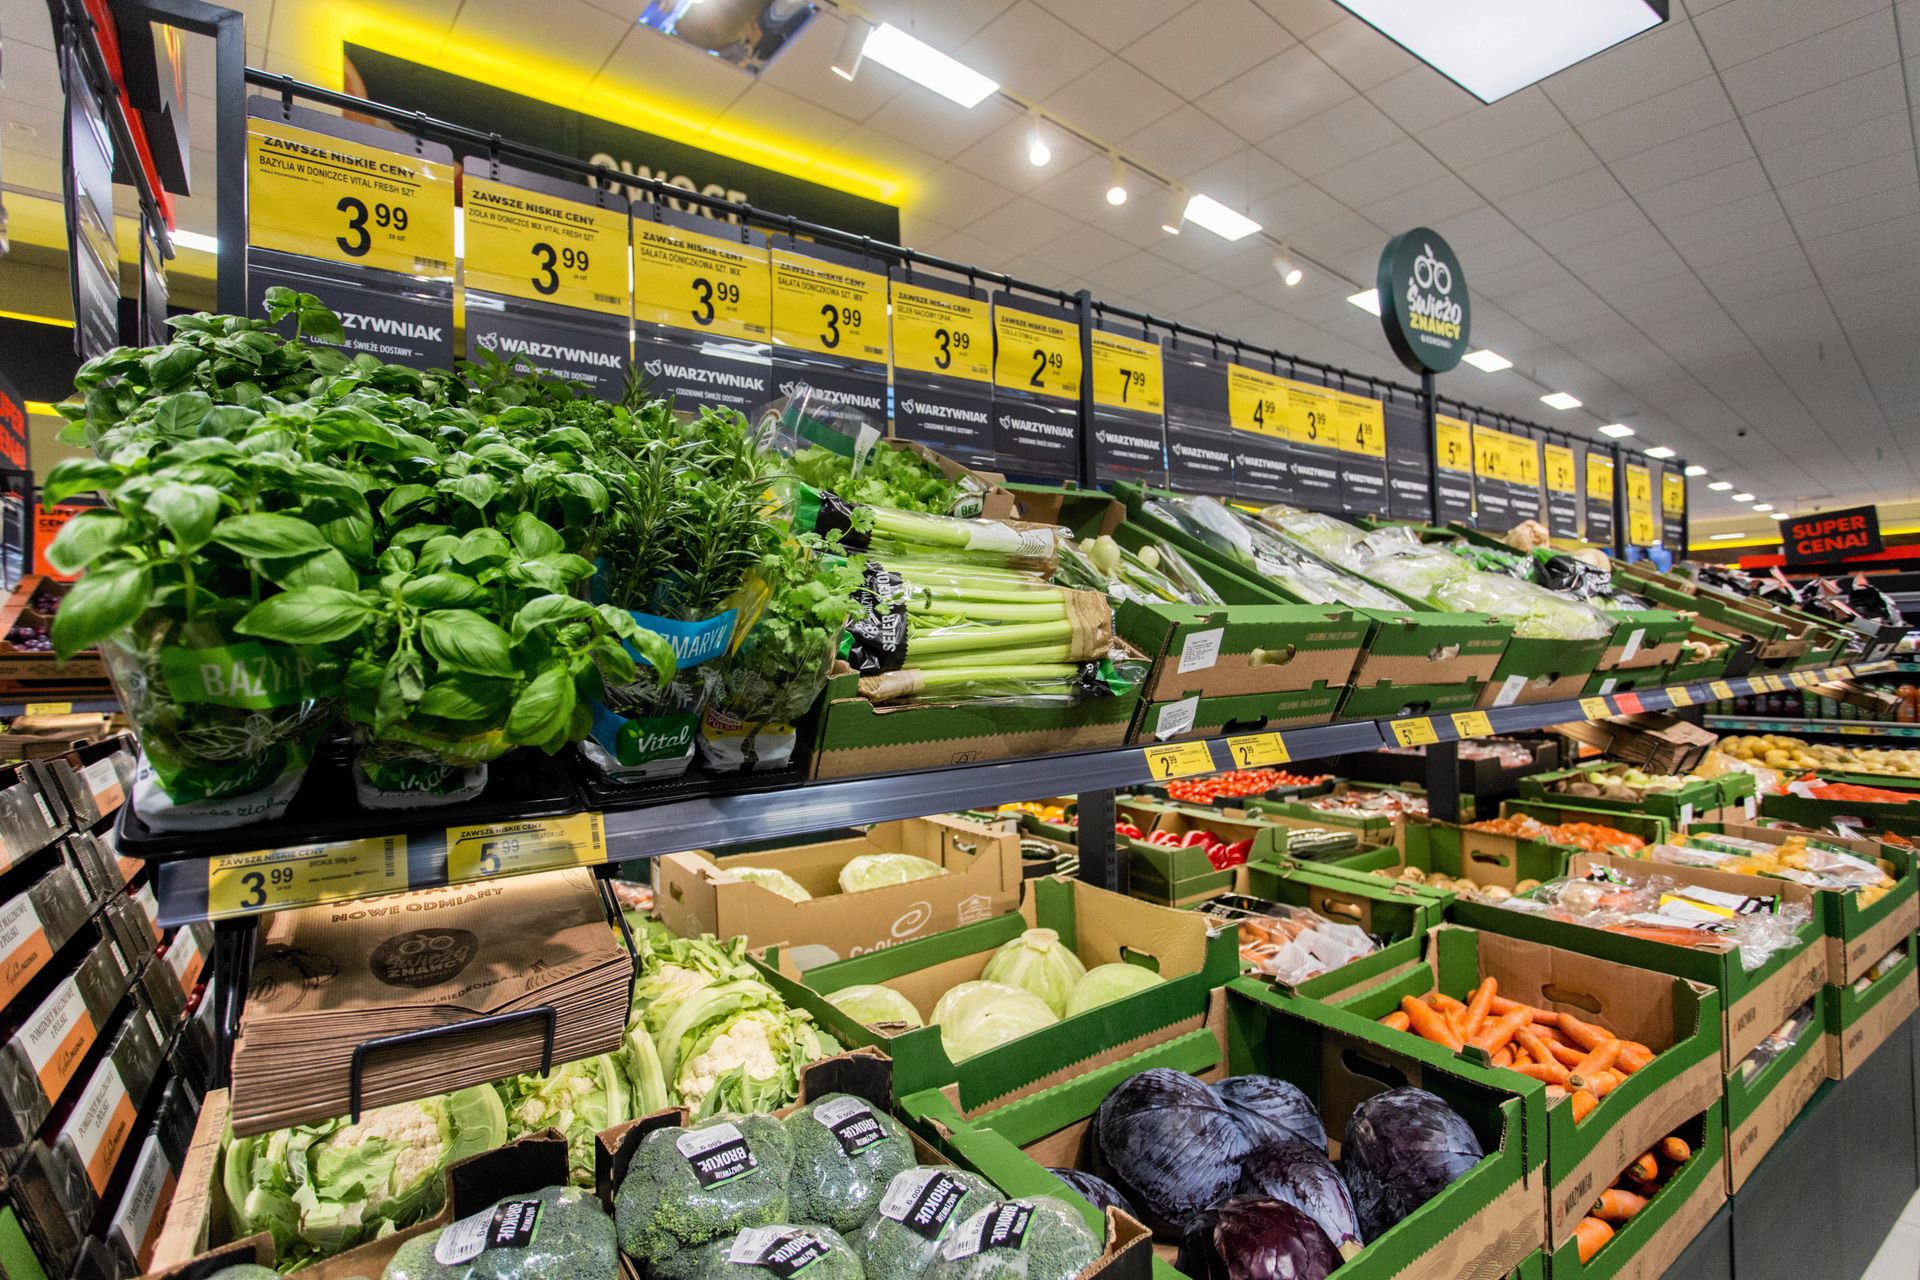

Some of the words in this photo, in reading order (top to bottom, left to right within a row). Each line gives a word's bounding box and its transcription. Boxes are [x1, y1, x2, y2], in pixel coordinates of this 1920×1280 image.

[263, 135, 327, 159] ZAWSZE
[331, 151, 376, 171] NISKIE
[379, 162, 415, 179] CENY
[259, 155, 295, 172] BAZYLIA
[297, 163, 305, 173] W
[307, 166, 348, 183] DONICZCE
[350, 176, 372, 188] VITAL
[374, 181, 399, 194] FRESH
[472, 190, 523, 209] ZAWSZE
[526, 203, 563, 218] NISKIE
[565, 212, 595, 225] CENY
[336, 196, 371, 257] 3
[375, 203, 408, 231] 99
[497, 214, 530, 228] DONICZCE
[562, 229, 582, 240] FRESH
[643, 232, 685, 248] ZAWSZE
[531, 242, 559, 295] 3
[562, 247, 589, 271] 99
[668, 253, 714, 270] DONICZKOWA
[691, 277, 714, 326] 3
[717, 281, 740, 304] 99
[820, 304, 840, 349] 3
[842, 307, 861, 327] 99
[353, 339, 379, 353] ŚWIEŻE
[380, 344, 413, 357] DOSTAWY
[500, 337, 622, 369] WARZYWNIAK
[934, 328, 951, 369] 3
[953, 331, 969, 349] 99
[663, 363, 764, 392] WARZYWNIAK
[1030, 349, 1047, 388] 2
[1048, 352, 1063, 369] 49
[1120, 368, 1132, 403] 7
[1133, 371, 1146, 387] 99
[915, 402, 988, 424] WARZYWNIAK
[1253, 399, 1264, 429] 4
[1307, 411, 1317, 440] 3
[1011, 418, 1074, 439] WARZYWNIAK
[1105, 432, 1160, 451] WARZYWNIAK
[1356, 423, 1365, 449] 4
[961, 503, 979, 516] BEZ
[1792, 515, 1867, 539] SUPER
[1796, 532, 1869, 555] CENA!
[882, 613, 897, 652] SELER
[638, 724, 690, 753] Vital
[1160, 757, 1173, 777] 2
[1239, 746, 1251, 766] 2
[460, 827, 494, 838] ZAWSZE
[219, 855, 264, 867] ZAWSZE
[480, 841, 501, 875] 5
[502, 839, 519, 853] 99
[240, 872, 267, 909] 3
[271, 867, 293, 885] 99
[331, 905, 400, 923] NOWE
[406, 887, 504, 911] ODMIANY
[839, 1118, 879, 1139] BROKUŁ
[697, 1146, 747, 1173] BROKUŁ
[912, 1185, 924, 1199] 500
[914, 1178, 954, 1225] BROKUŁ
[496, 1203, 524, 1242] BROKUŁ
[990, 1205, 1019, 1244] BROKUŁ
[767, 1235, 814, 1263] BROKUŁ
